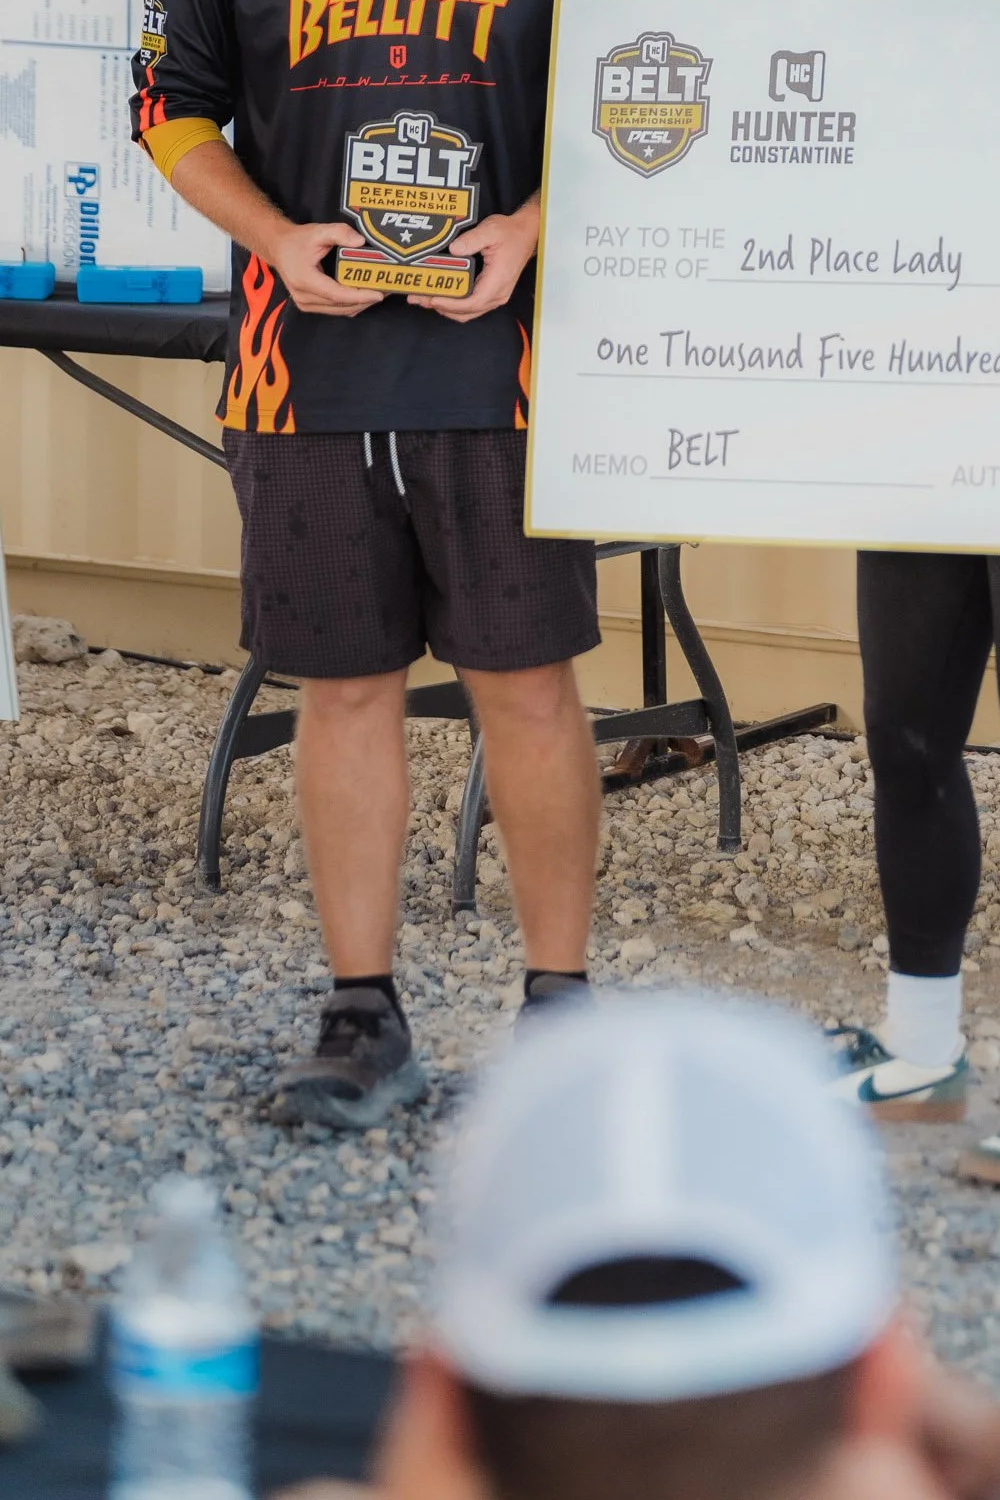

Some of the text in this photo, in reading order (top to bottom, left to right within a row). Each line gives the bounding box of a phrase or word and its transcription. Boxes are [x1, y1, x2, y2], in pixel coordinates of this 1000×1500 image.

[316, 73, 472, 88] HOWITZER
[790, 63, 810, 83] HC
[602, 66, 703, 102] BELT
[609, 107, 693, 117] DEFENSIVE
[609, 117, 693, 126] CHAMPIONSHIP
[409, 125, 420, 134] HC
[731, 111, 857, 142] HUNTER
[627, 130, 672, 144] PCSL
[730, 145, 854, 164] CONSTANTINE
[351, 142, 470, 187] BELT
[360, 186, 458, 203] DEFENSIVE
[360, 196, 457, 211] CHAMPIONSHIP
[380, 212, 434, 230] PCSL
[585, 226, 726, 249] PAY TO THE
[583, 256, 667, 278] ORDER
[675, 258, 709, 278] OF
[740, 234, 794, 272] 2nd
[810, 237, 880, 275] Place
[893, 237, 962, 291] Lady
[343, 268, 464, 290] 2ND PLACE LADY
[660, 330, 803, 371] Thousand
[819, 333, 875, 379] Five
[572, 453, 648, 477] MEMO
[668, 428, 740, 471] BELT
